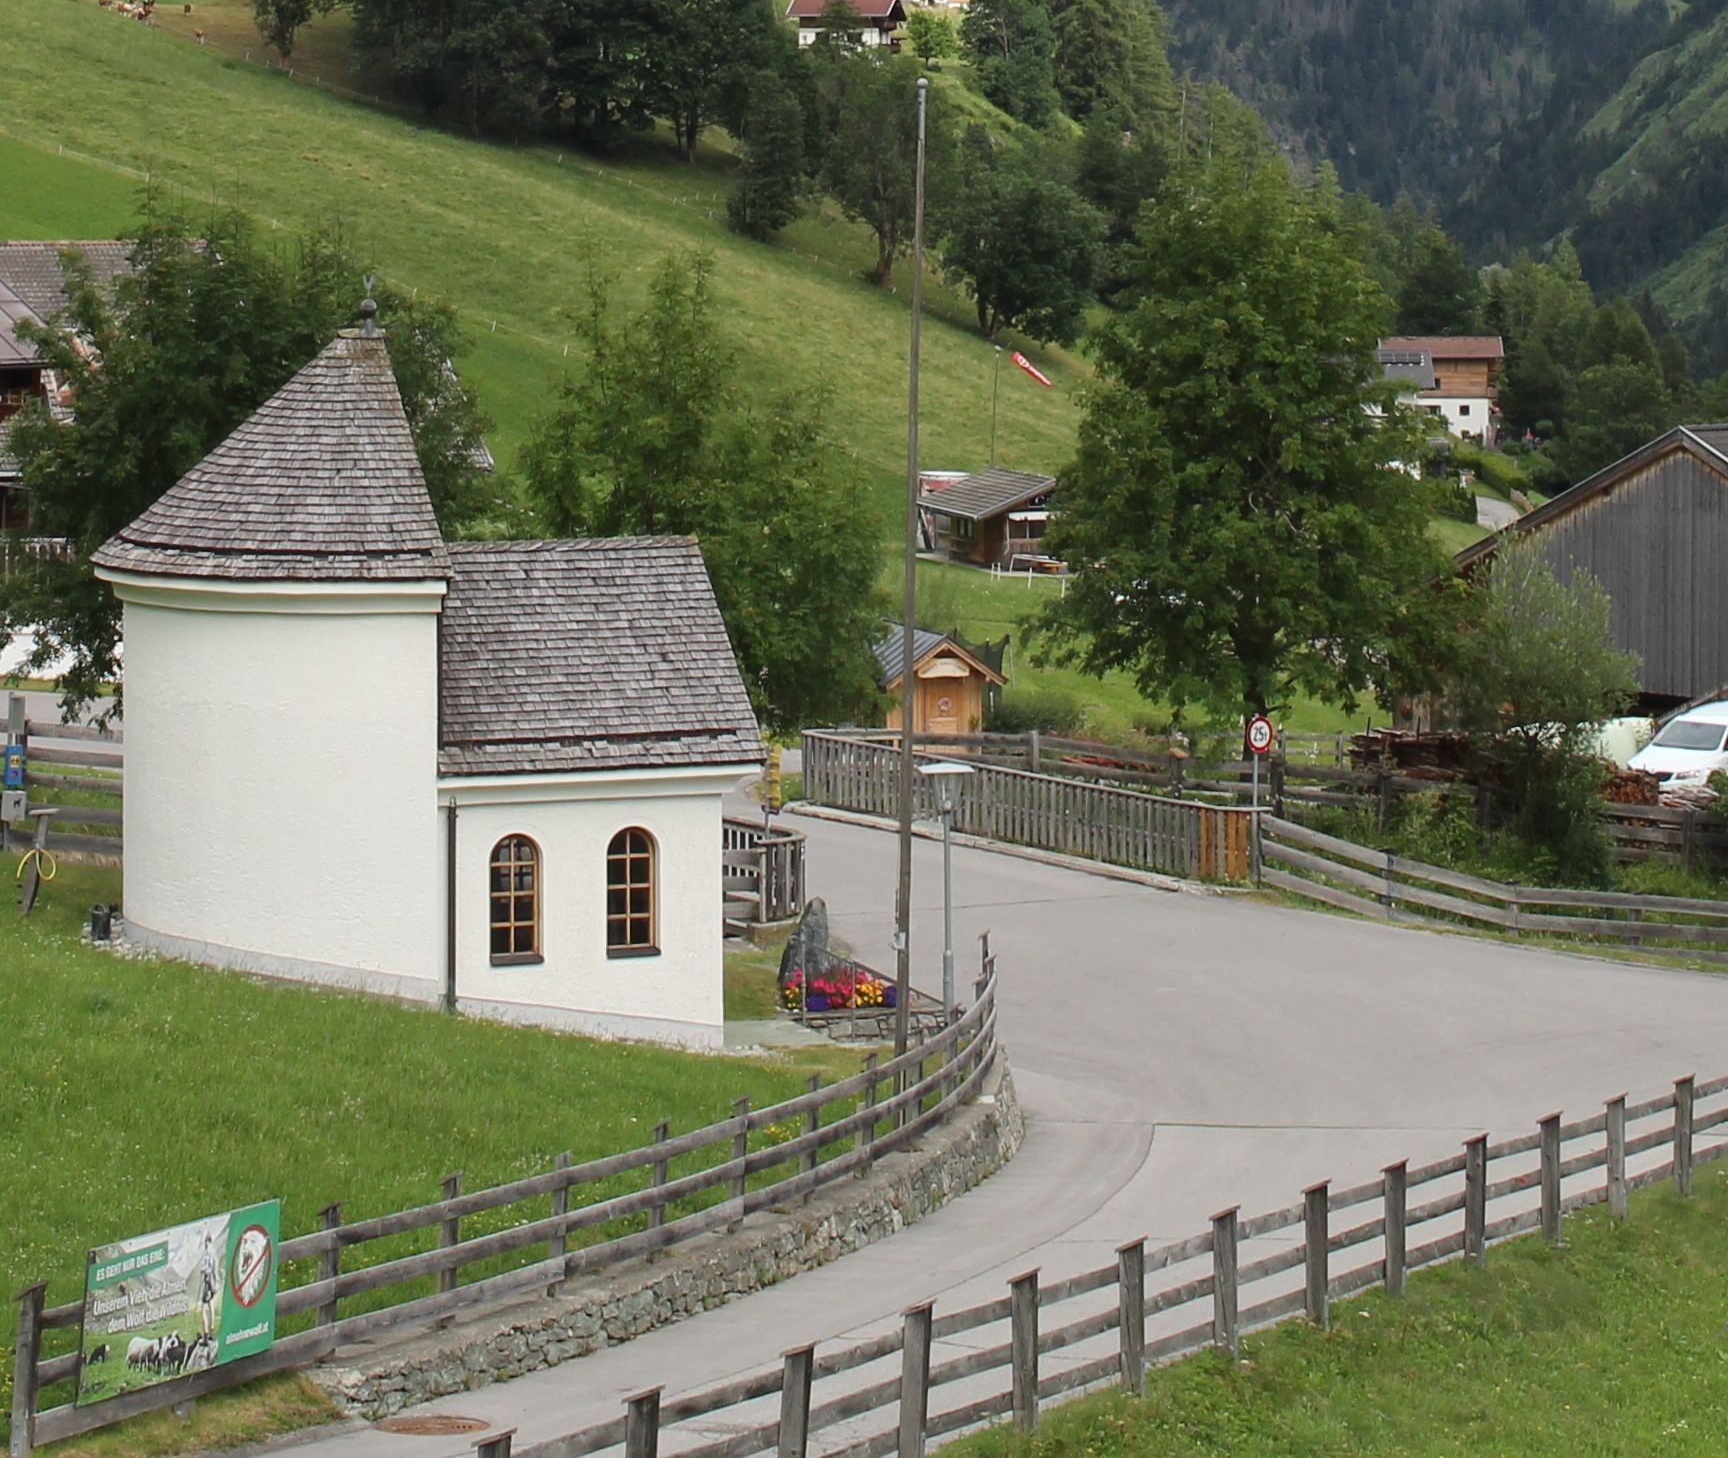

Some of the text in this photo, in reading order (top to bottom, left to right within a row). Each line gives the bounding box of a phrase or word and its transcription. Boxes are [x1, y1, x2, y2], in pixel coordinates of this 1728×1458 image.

[96, 1267, 105, 1282] ES
[105, 1262, 122, 1279] GEHT
[122, 1257, 136, 1273] NUR
[136, 1253, 149, 1269] DAS
[93, 1295, 129, 1316] Unserem
[126, 1308, 145, 1328] Wolf
